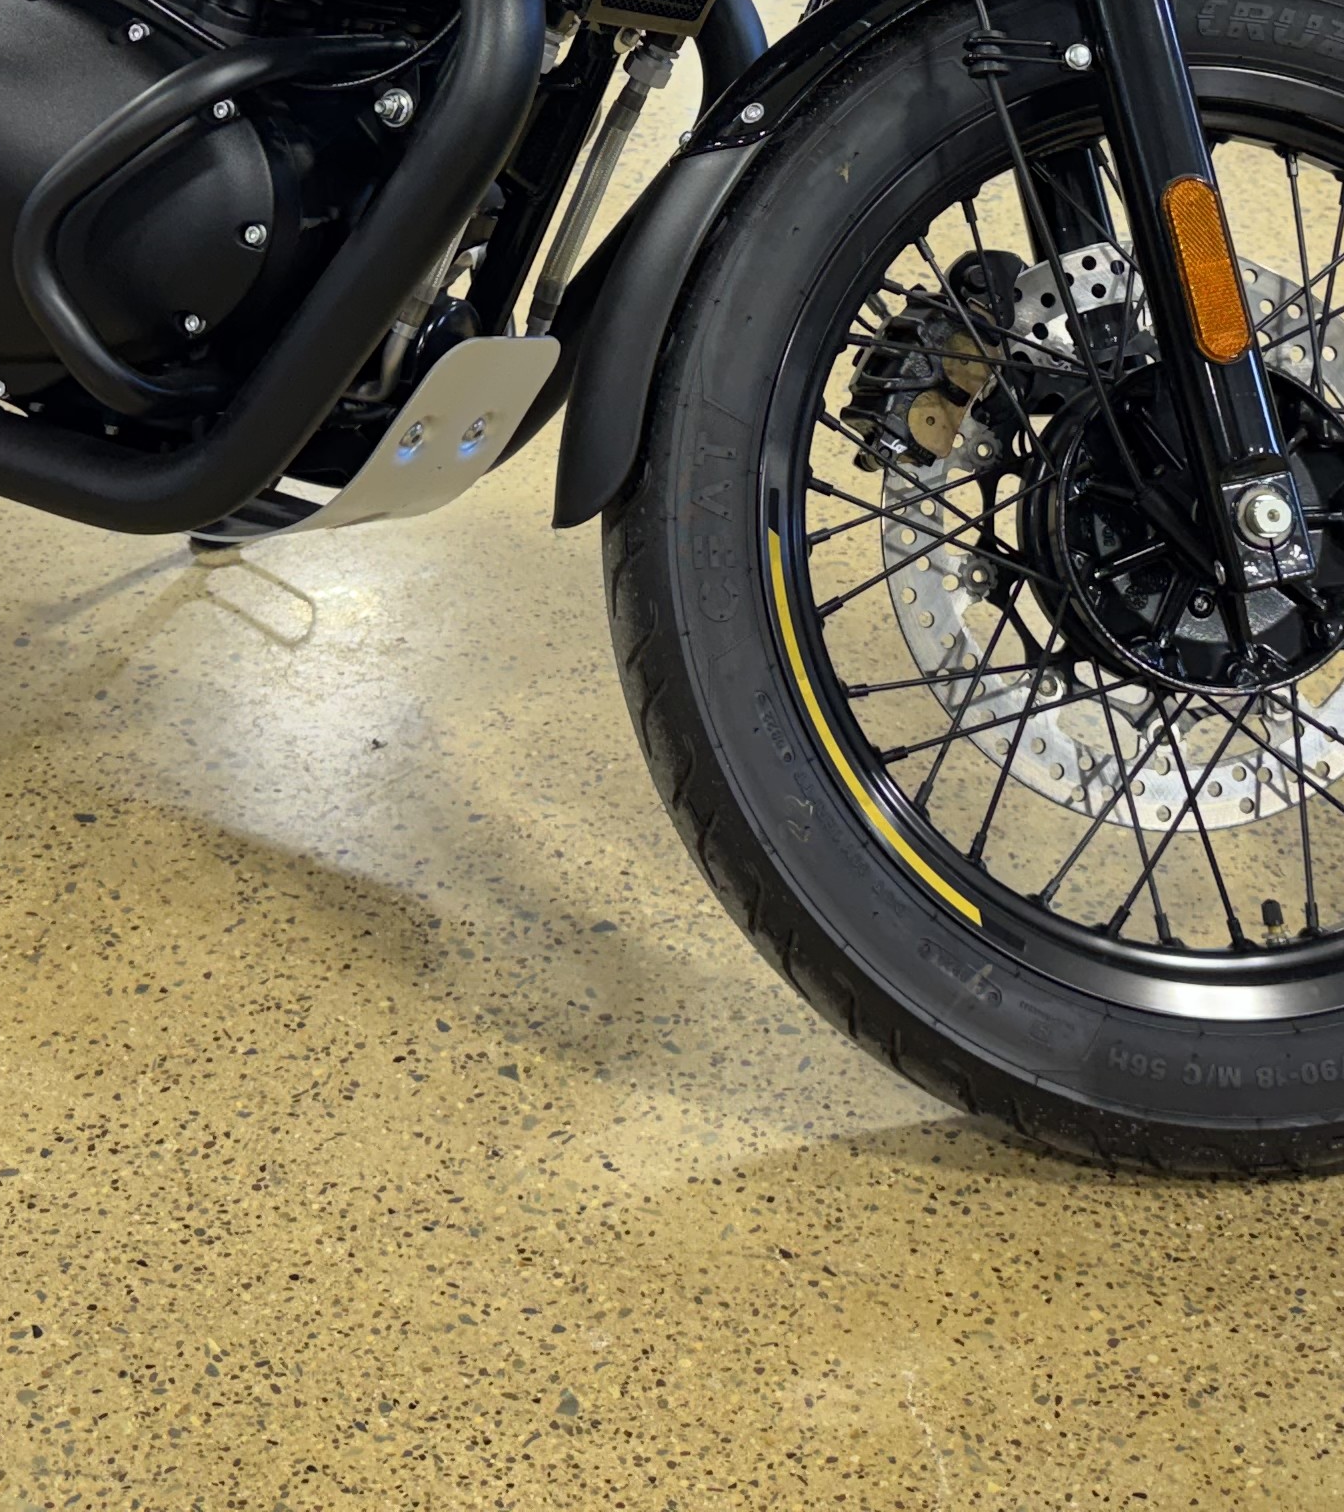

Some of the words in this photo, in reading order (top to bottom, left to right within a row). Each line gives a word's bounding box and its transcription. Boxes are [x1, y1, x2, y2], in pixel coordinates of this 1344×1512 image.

[692, 429, 739, 623] CEAT
[1108, 1046, 1166, 1080] 56H
[1183, 1061, 1242, 1088] M/C
